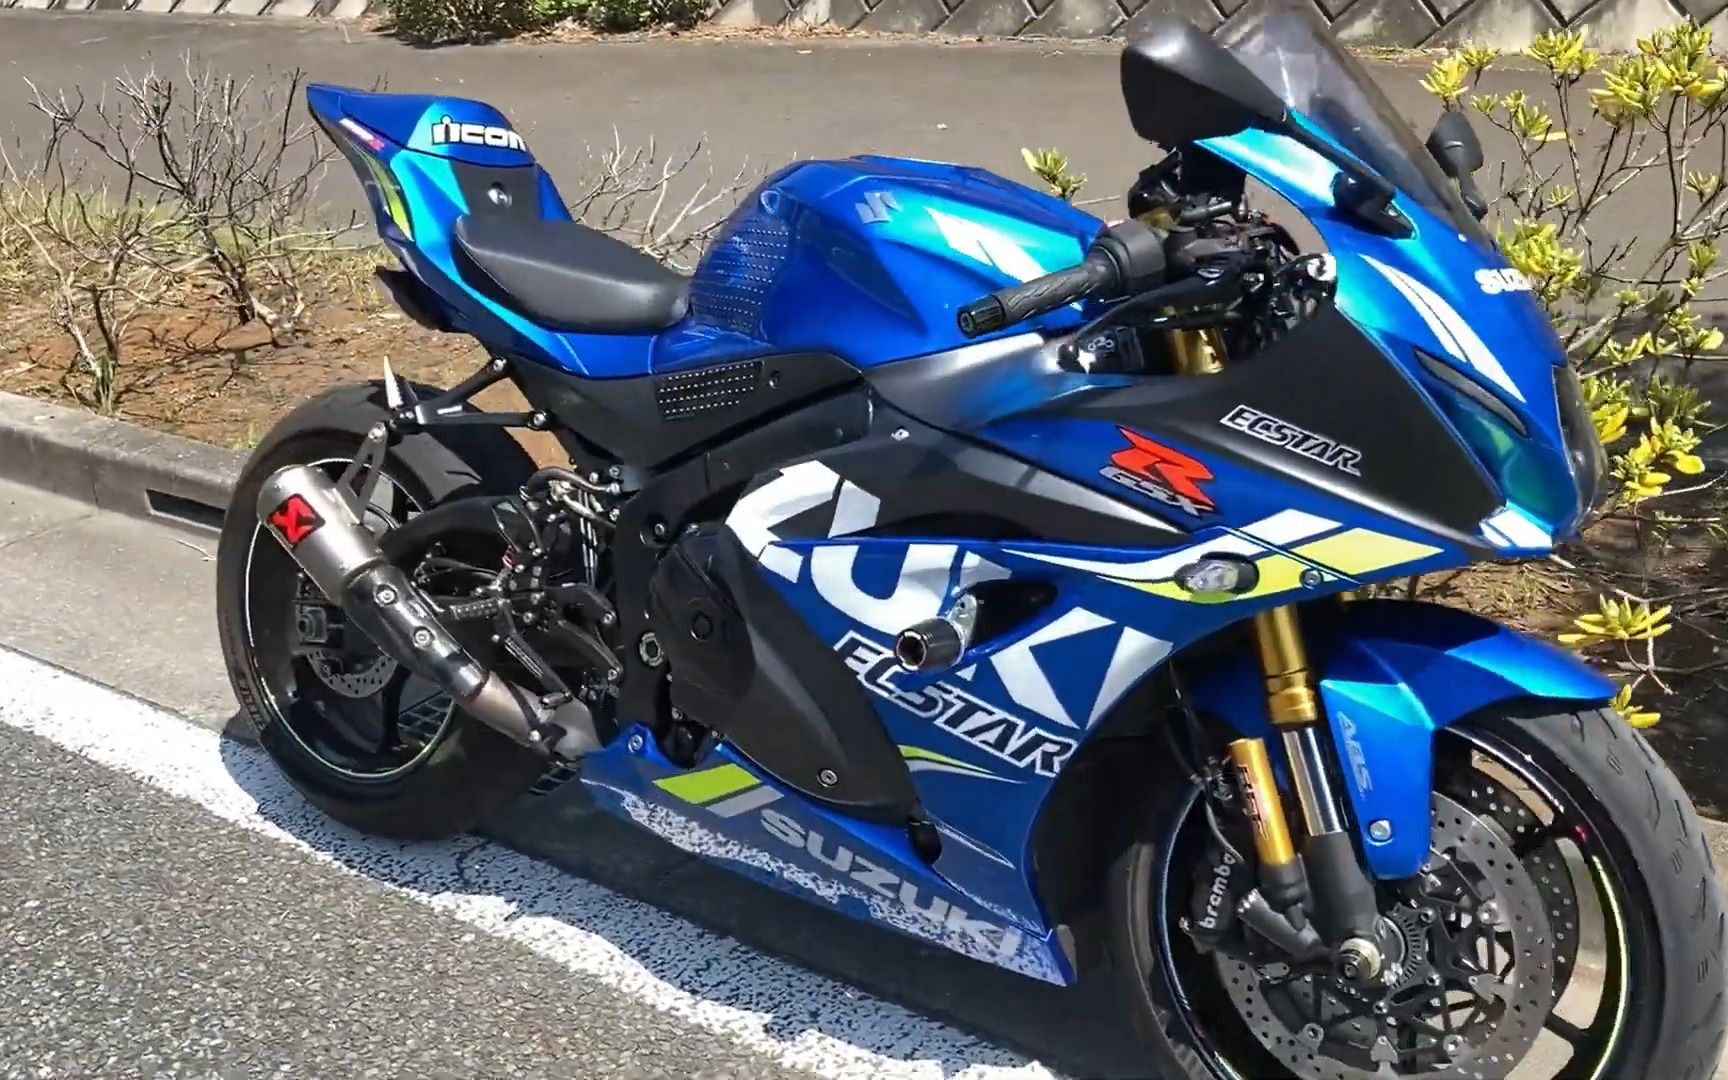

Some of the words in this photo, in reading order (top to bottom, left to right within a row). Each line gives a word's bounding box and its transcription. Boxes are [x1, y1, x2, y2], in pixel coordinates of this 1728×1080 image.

[1219, 404, 1362, 477] ECSTAR
[832, 629, 1080, 778] ECSTAR
[759, 808, 1023, 957] SUZUKI
